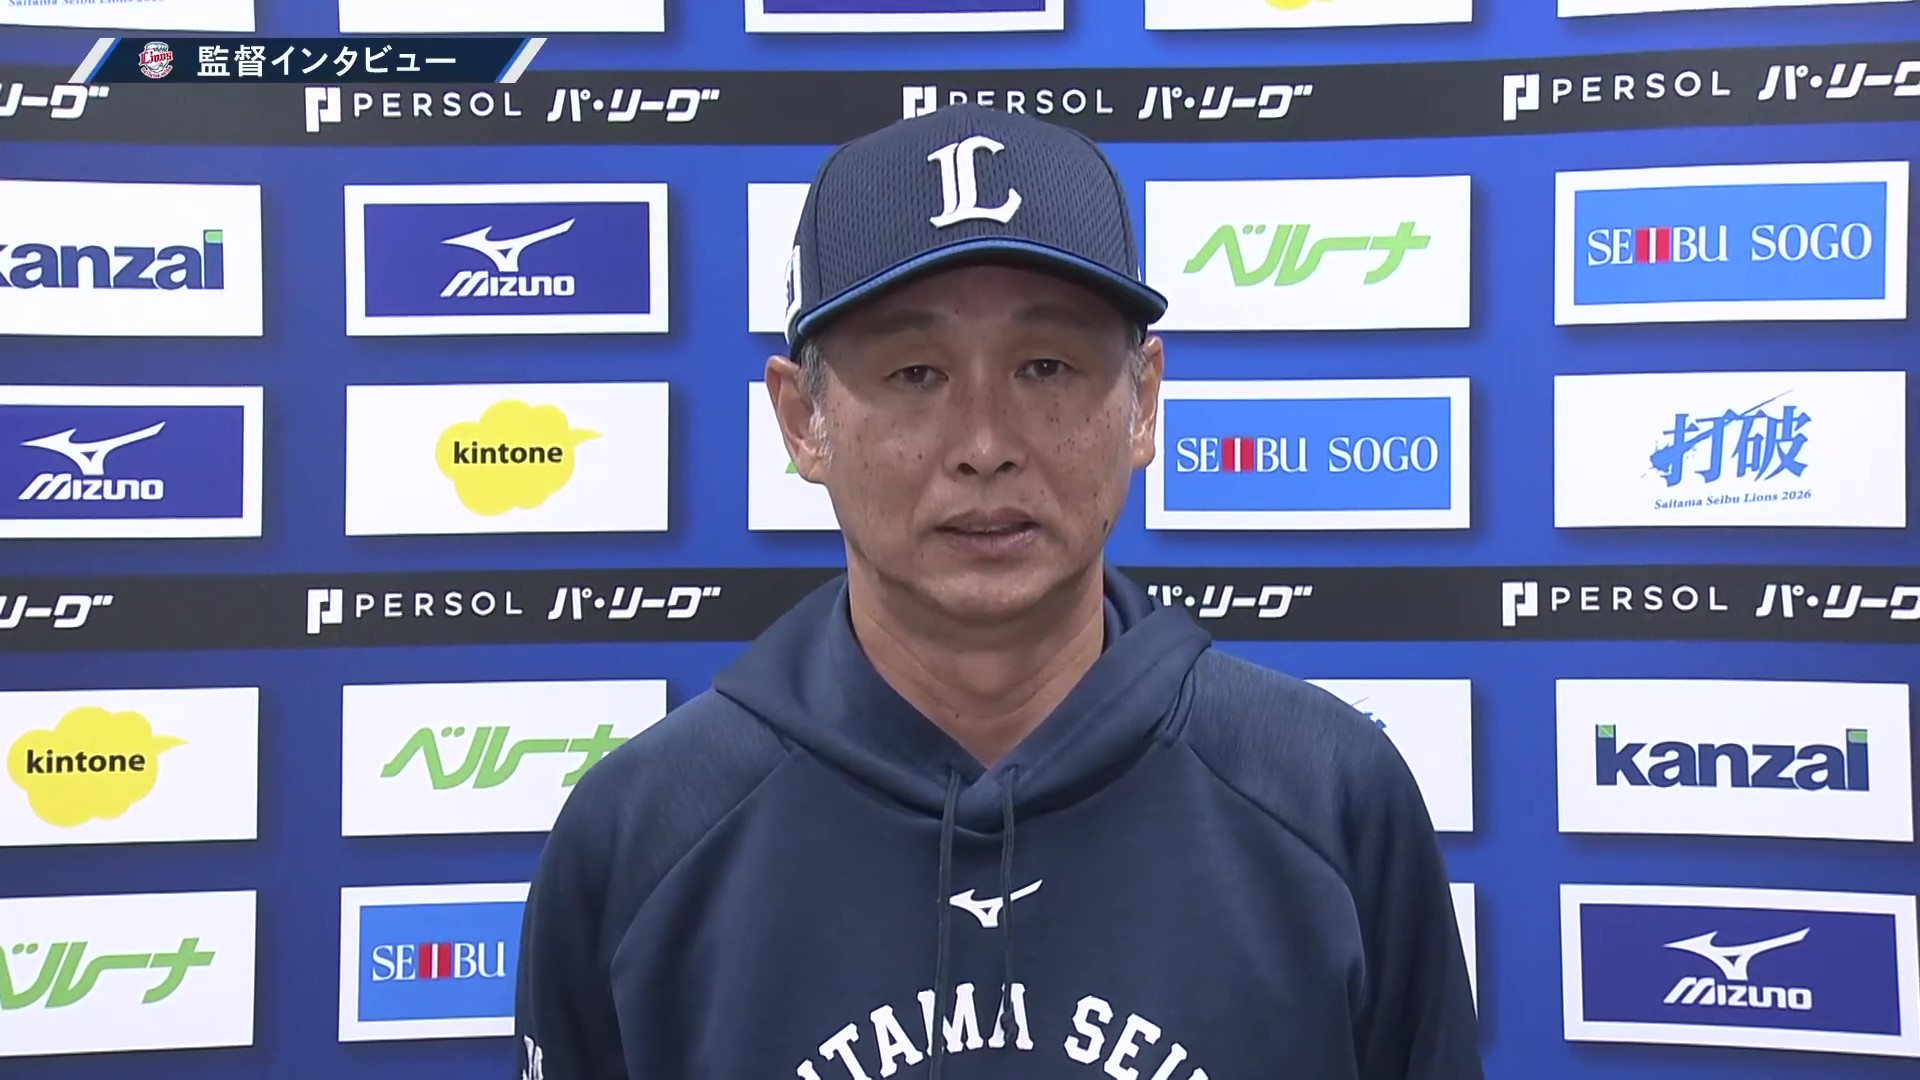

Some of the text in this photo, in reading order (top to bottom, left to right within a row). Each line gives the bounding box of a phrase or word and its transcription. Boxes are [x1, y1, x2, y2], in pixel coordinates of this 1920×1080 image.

[1138, 84, 1313, 119] パ・リーグ
[1553, 70, 1731, 103] PERSOL
[354, 87, 720, 122] PERSOL パ・リーグ
[928, 136, 1022, 228] L
[1183, 220, 1431, 287] ベルーナ
[1587, 223, 1873, 266] SEIBU SOGO
[441, 271, 575, 298] MIZUNO
[453, 441, 563, 466] kintone
[1176, 436, 1439, 473] SEIBU SOGO
[1650, 398, 1812, 487] 打破
[18, 473, 164, 501] MIZUNO
[1654, 489, 1812, 509] Saitama Seibu Lions 2026
[355, 587, 721, 620] PERSOL パ・リーグ
[1551, 586, 1728, 612] PERSOL
[26, 749, 146, 775] kintone
[1595, 724, 1870, 792] kanzai
[371, 942, 505, 982] SEIBU
[1663, 977, 1812, 1010] MIZUNO
